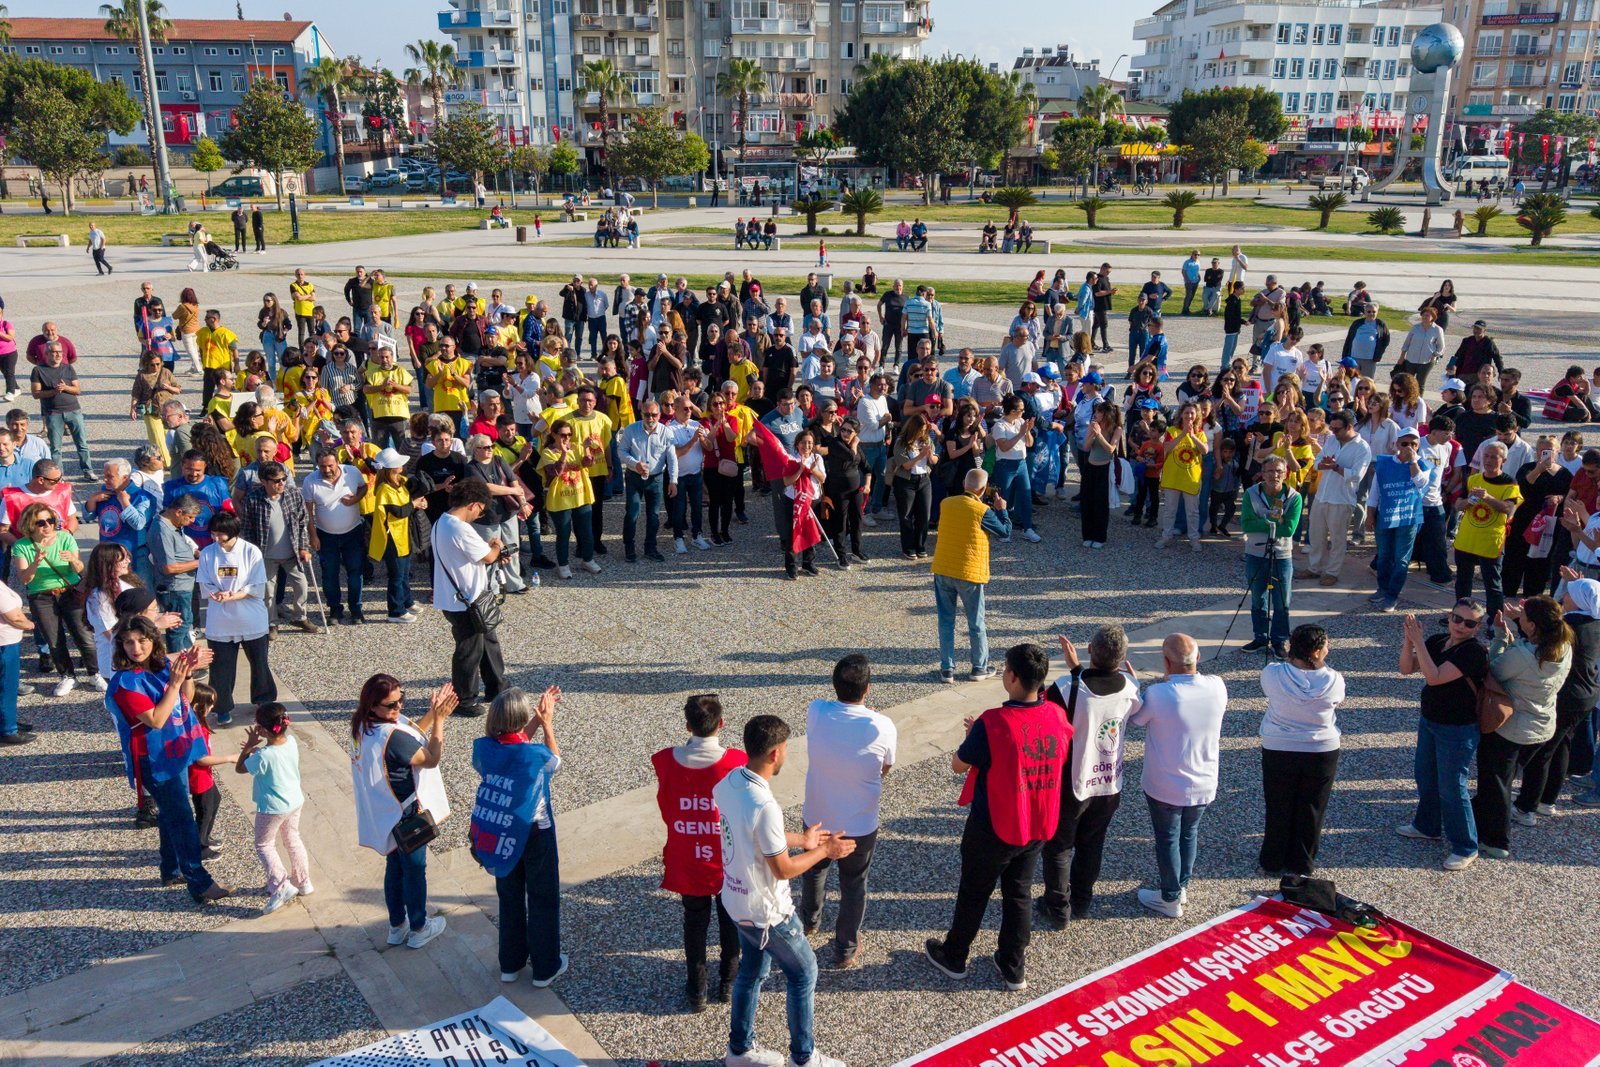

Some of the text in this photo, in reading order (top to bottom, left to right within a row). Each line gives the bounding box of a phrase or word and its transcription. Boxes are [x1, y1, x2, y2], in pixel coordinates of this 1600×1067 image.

[1085, 775, 1113, 789] PEYW
[478, 786, 513, 808] YLEM
[473, 804, 513, 828] RENİŞ
[674, 819, 721, 835] GENE
[695, 841, 714, 862] İŞ
[1077, 968, 1208, 1037] SEZONLUK
[1183, 926, 1294, 982] İŞÇİLİĞE
[1277, 908, 1333, 939] HAY
[1226, 990, 1280, 1028] 1
[1320, 971, 1436, 1039] ÖRGÜTÜ
[429, 1014, 493, 1053] ATAT
